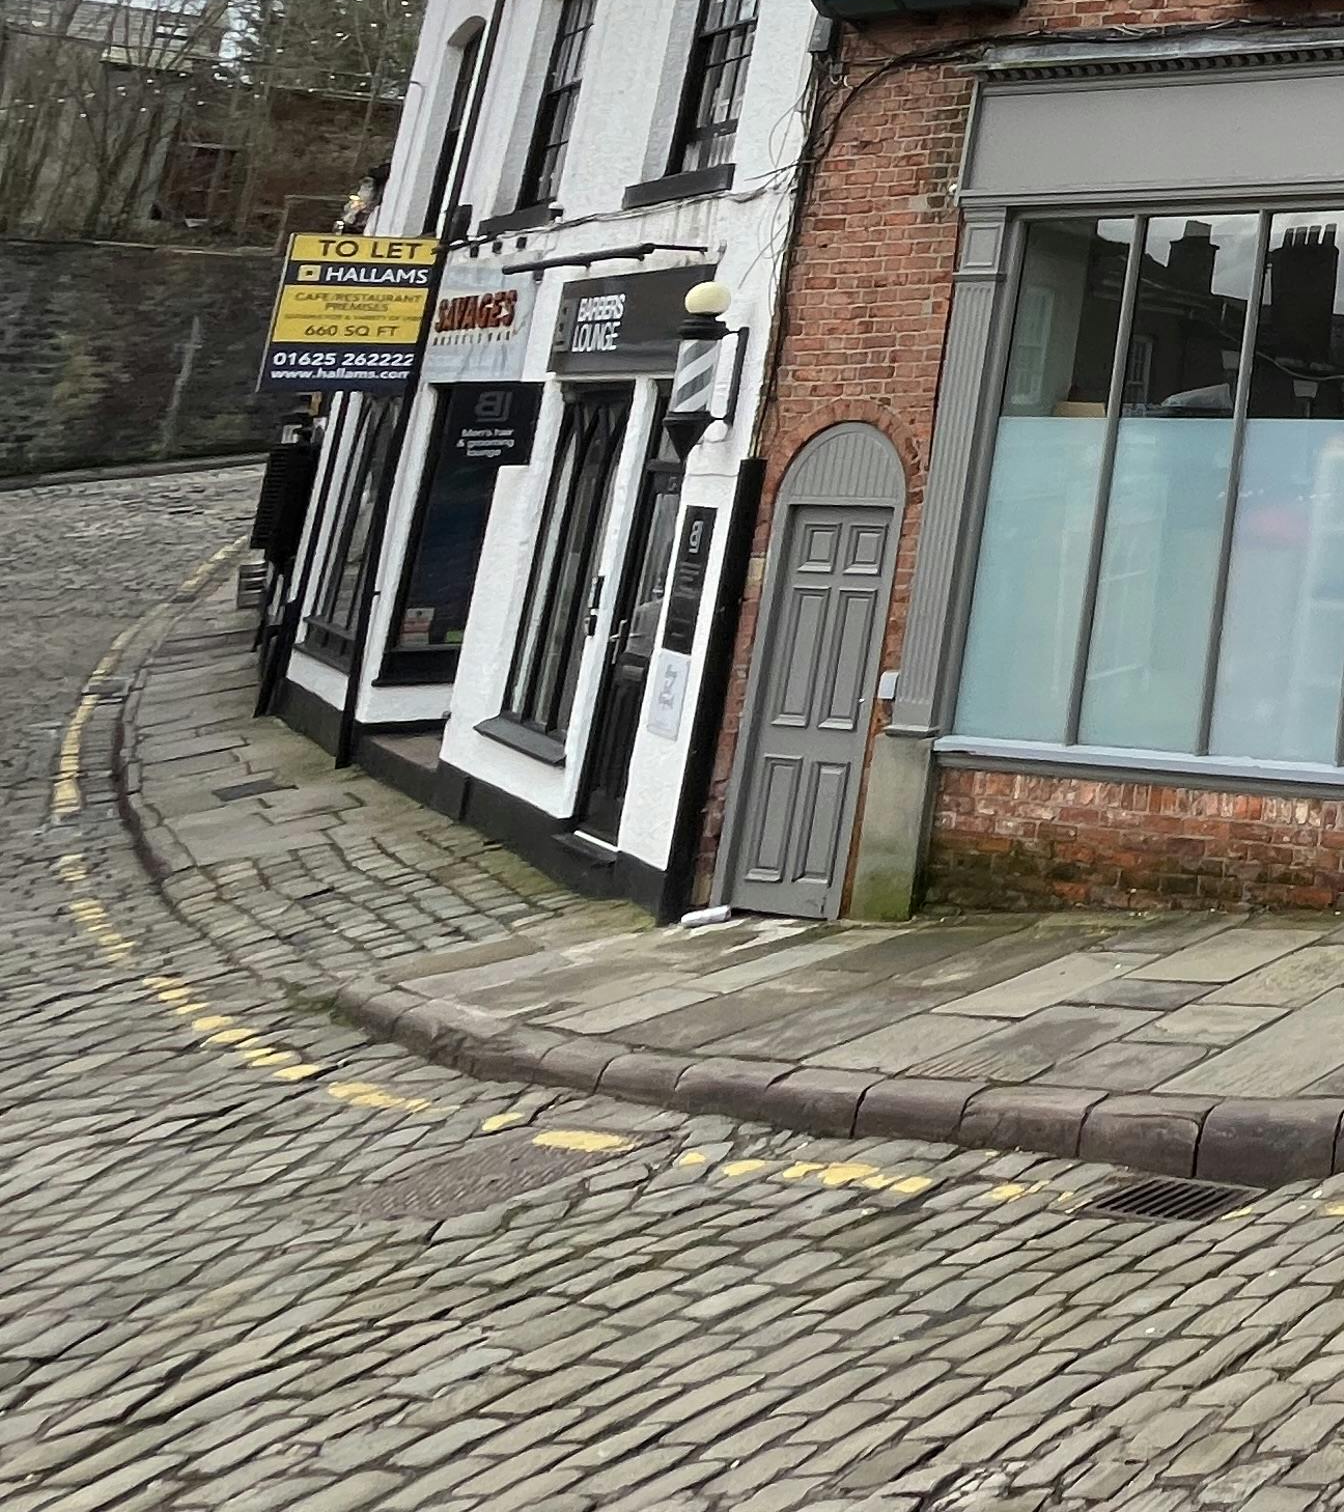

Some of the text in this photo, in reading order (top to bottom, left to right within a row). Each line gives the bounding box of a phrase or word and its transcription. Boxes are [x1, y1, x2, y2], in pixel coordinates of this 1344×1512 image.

[318, 239, 423, 260] TO LET
[325, 266, 429, 284] HALLAMS
[434, 289, 518, 334] SAVAGES
[577, 293, 626, 322] BARBERS
[304, 324, 399, 337] 660 SQ FT
[571, 321, 622, 353] LOUNGE
[272, 352, 415, 367] 01625 262222
